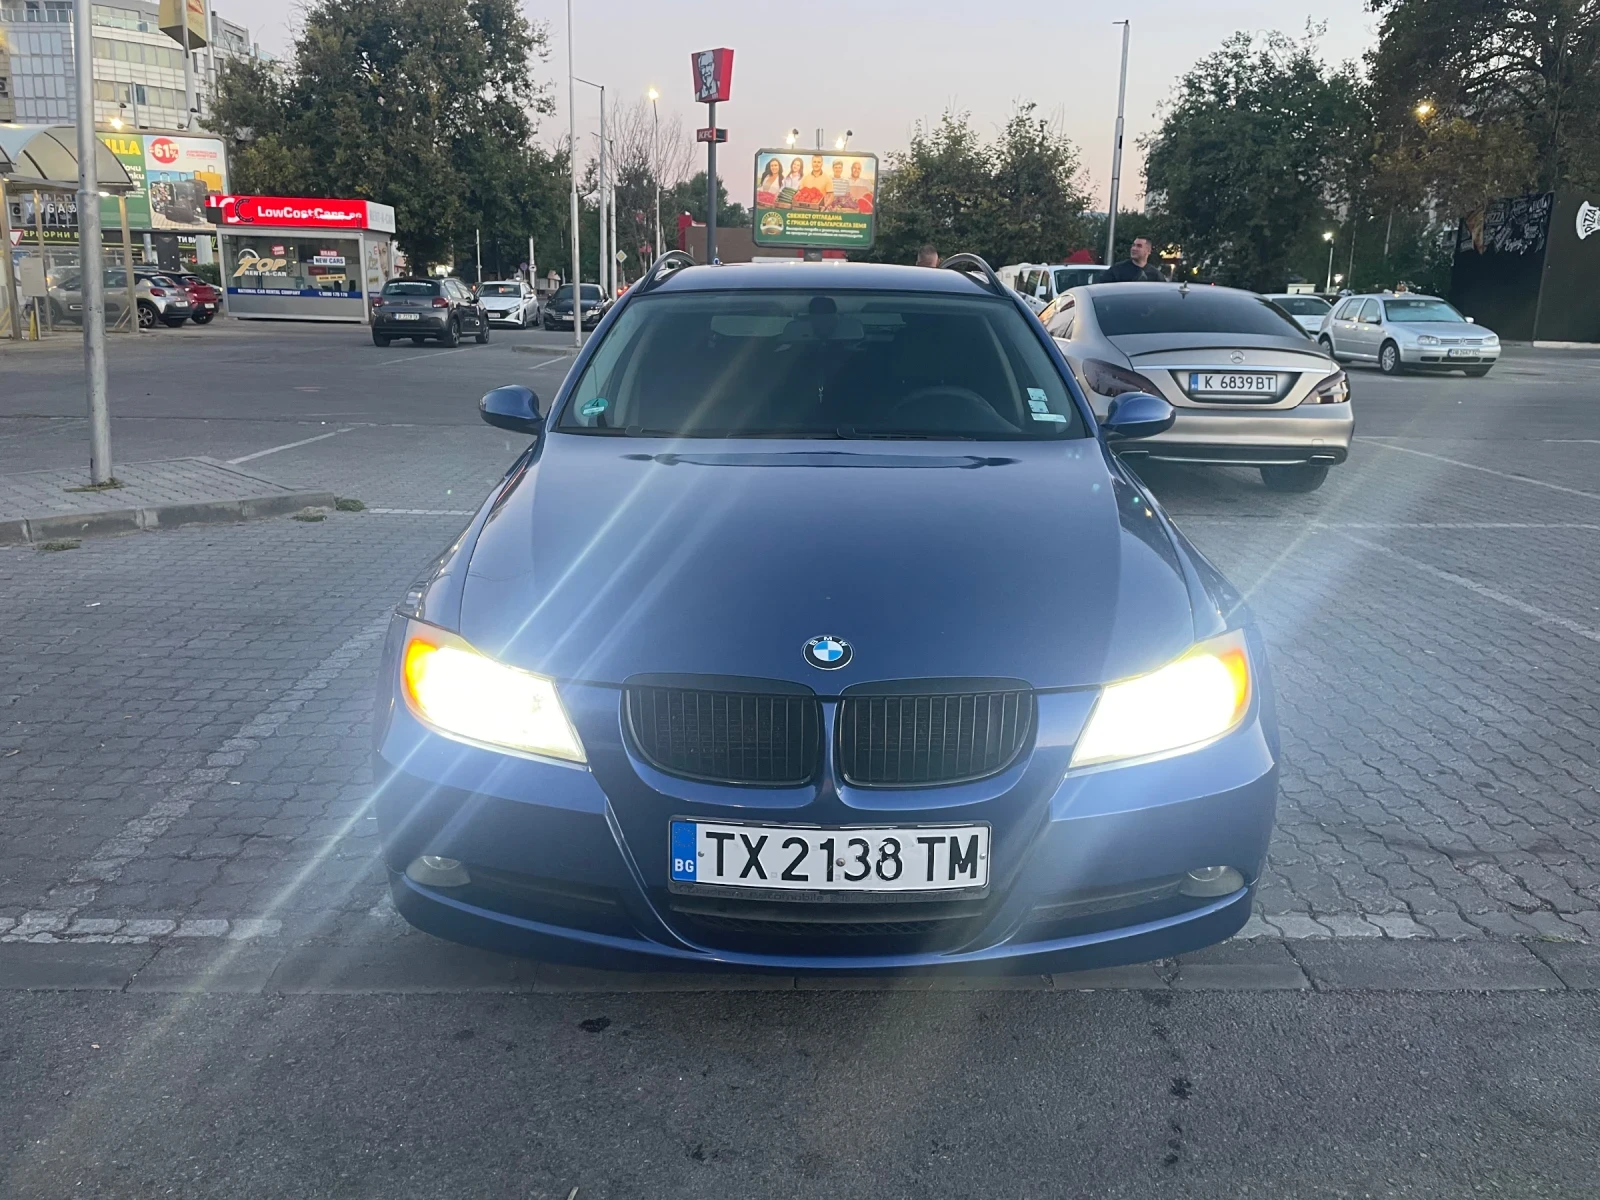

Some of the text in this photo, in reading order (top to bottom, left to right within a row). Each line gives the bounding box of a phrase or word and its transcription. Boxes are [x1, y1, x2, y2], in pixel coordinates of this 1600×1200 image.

[698, 130, 713, 139] KFC
[102, 138, 141, 156] ILLA
[233, 257, 287, 277] TOP
[1204, 375, 1274, 390] K 6839 BT
[809, 635, 848, 647] BMW
[706, 831, 980, 882] TX 2138 TM
[674, 857, 695, 873] BG
